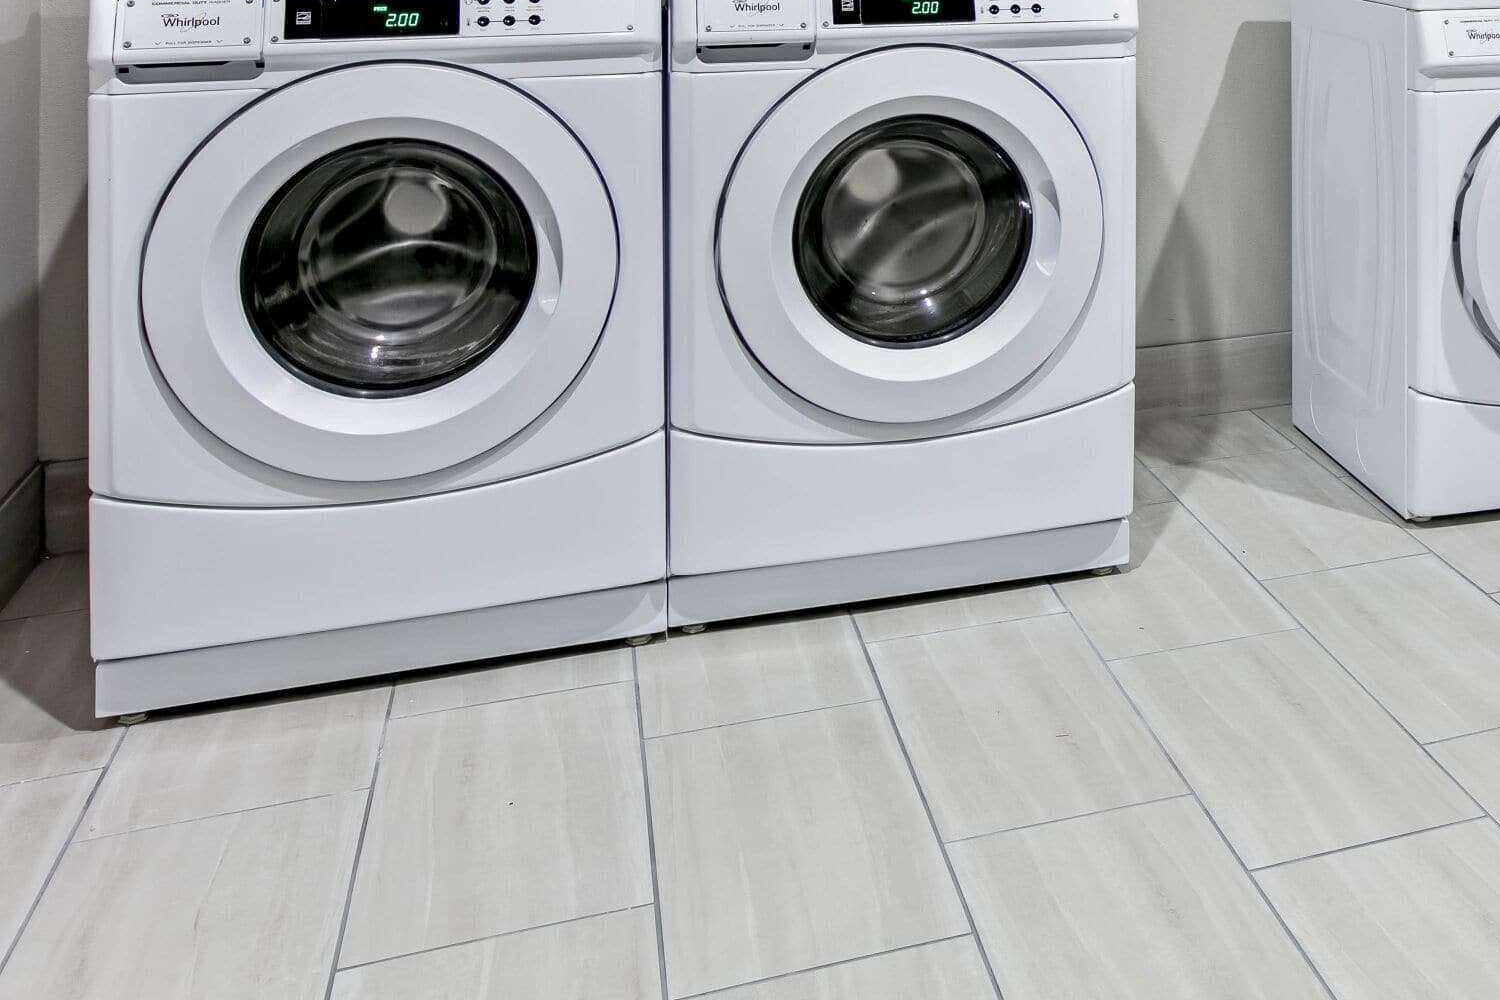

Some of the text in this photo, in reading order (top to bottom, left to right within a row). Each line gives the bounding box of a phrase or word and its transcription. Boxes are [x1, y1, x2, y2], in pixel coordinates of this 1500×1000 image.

[734, 2, 781, 13] Whirlpool
[911, 1, 939, 15] 2.00
[162, 16, 220, 29] Whirlpool
[385, 12, 420, 27] 2.00
